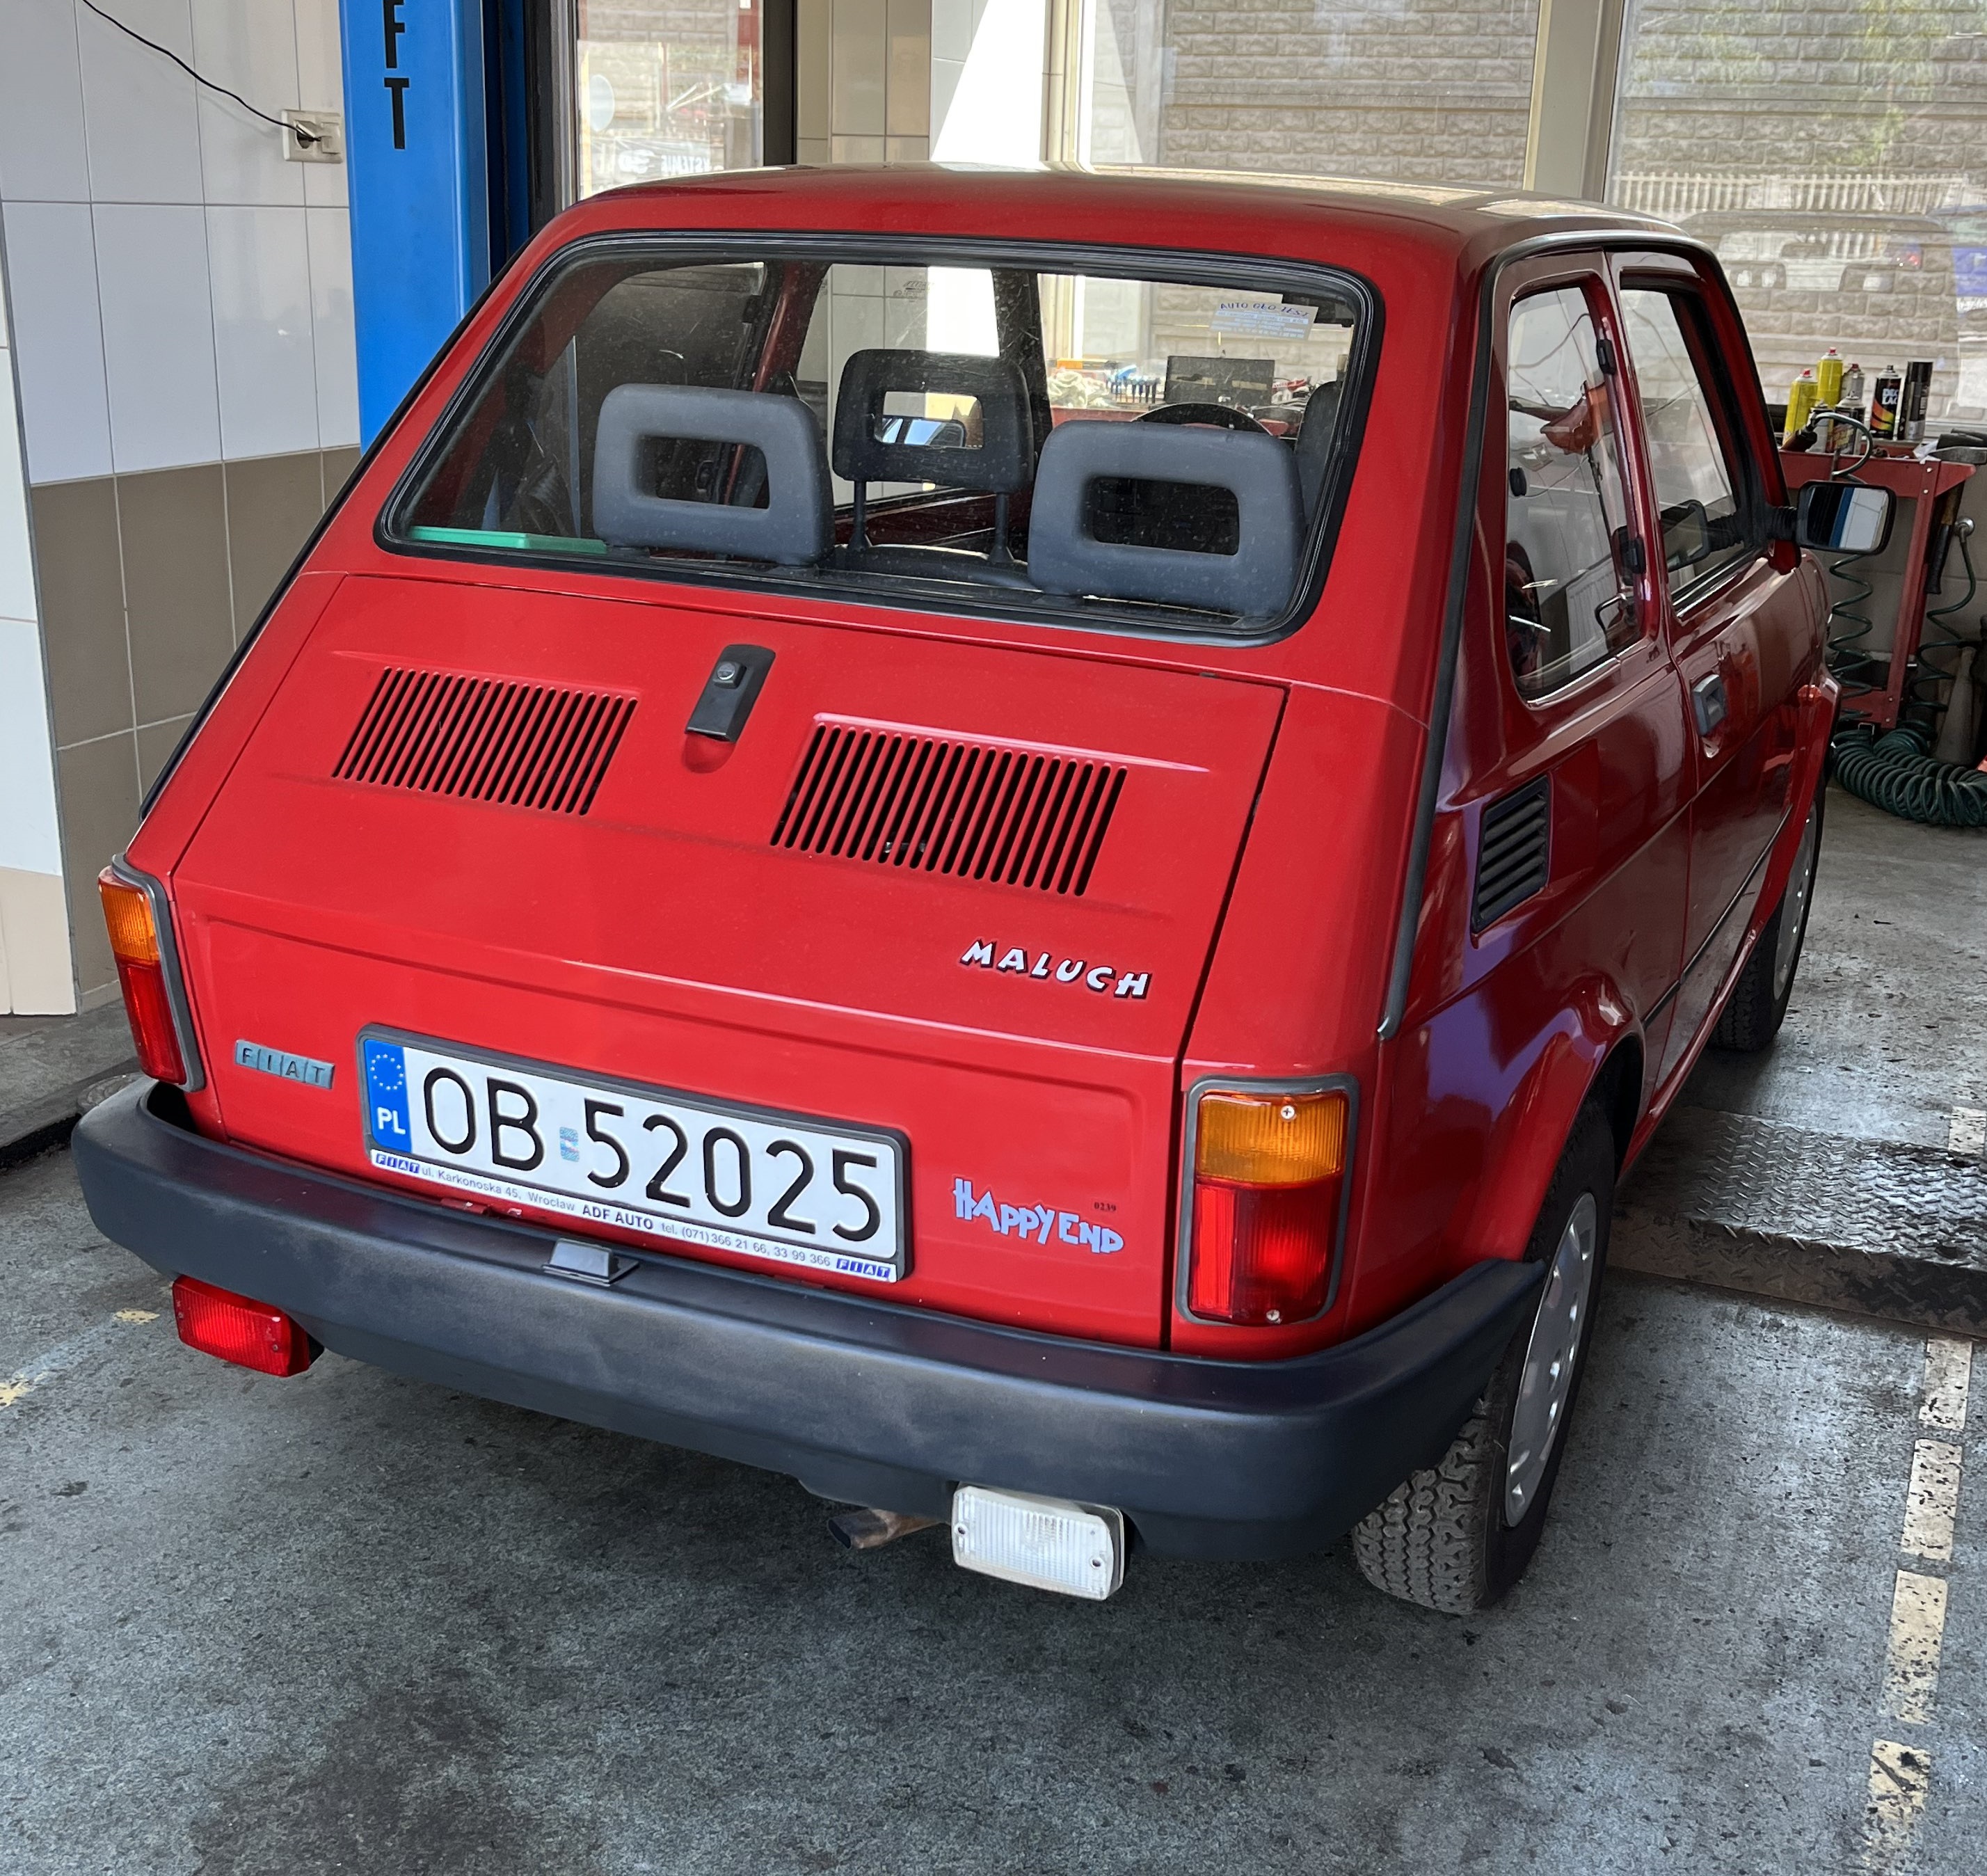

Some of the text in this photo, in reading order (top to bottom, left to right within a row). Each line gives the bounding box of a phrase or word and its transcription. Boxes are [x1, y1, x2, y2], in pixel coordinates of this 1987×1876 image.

[960, 938, 1152, 999] MALUCH
[240, 1046, 327, 1085] FIAT
[377, 1106, 406, 1136] PL
[423, 1066, 881, 1243] OB 52025
[376, 1152, 420, 1174] FIAT
[422, 1166, 434, 1178] ul.
[438, 1170, 502, 1195] Karkonoska
[582, 1204, 611, 1220] ADF
[615, 1211, 654, 1230] AUTO
[661, 1222, 678, 1235] tel.
[735, 1238, 748, 1250] 21
[774, 1246, 788, 1258] 33
[792, 1250, 806, 1262] 99
[809, 1254, 831, 1266] 366
[836, 1257, 891, 1279] FIAT
